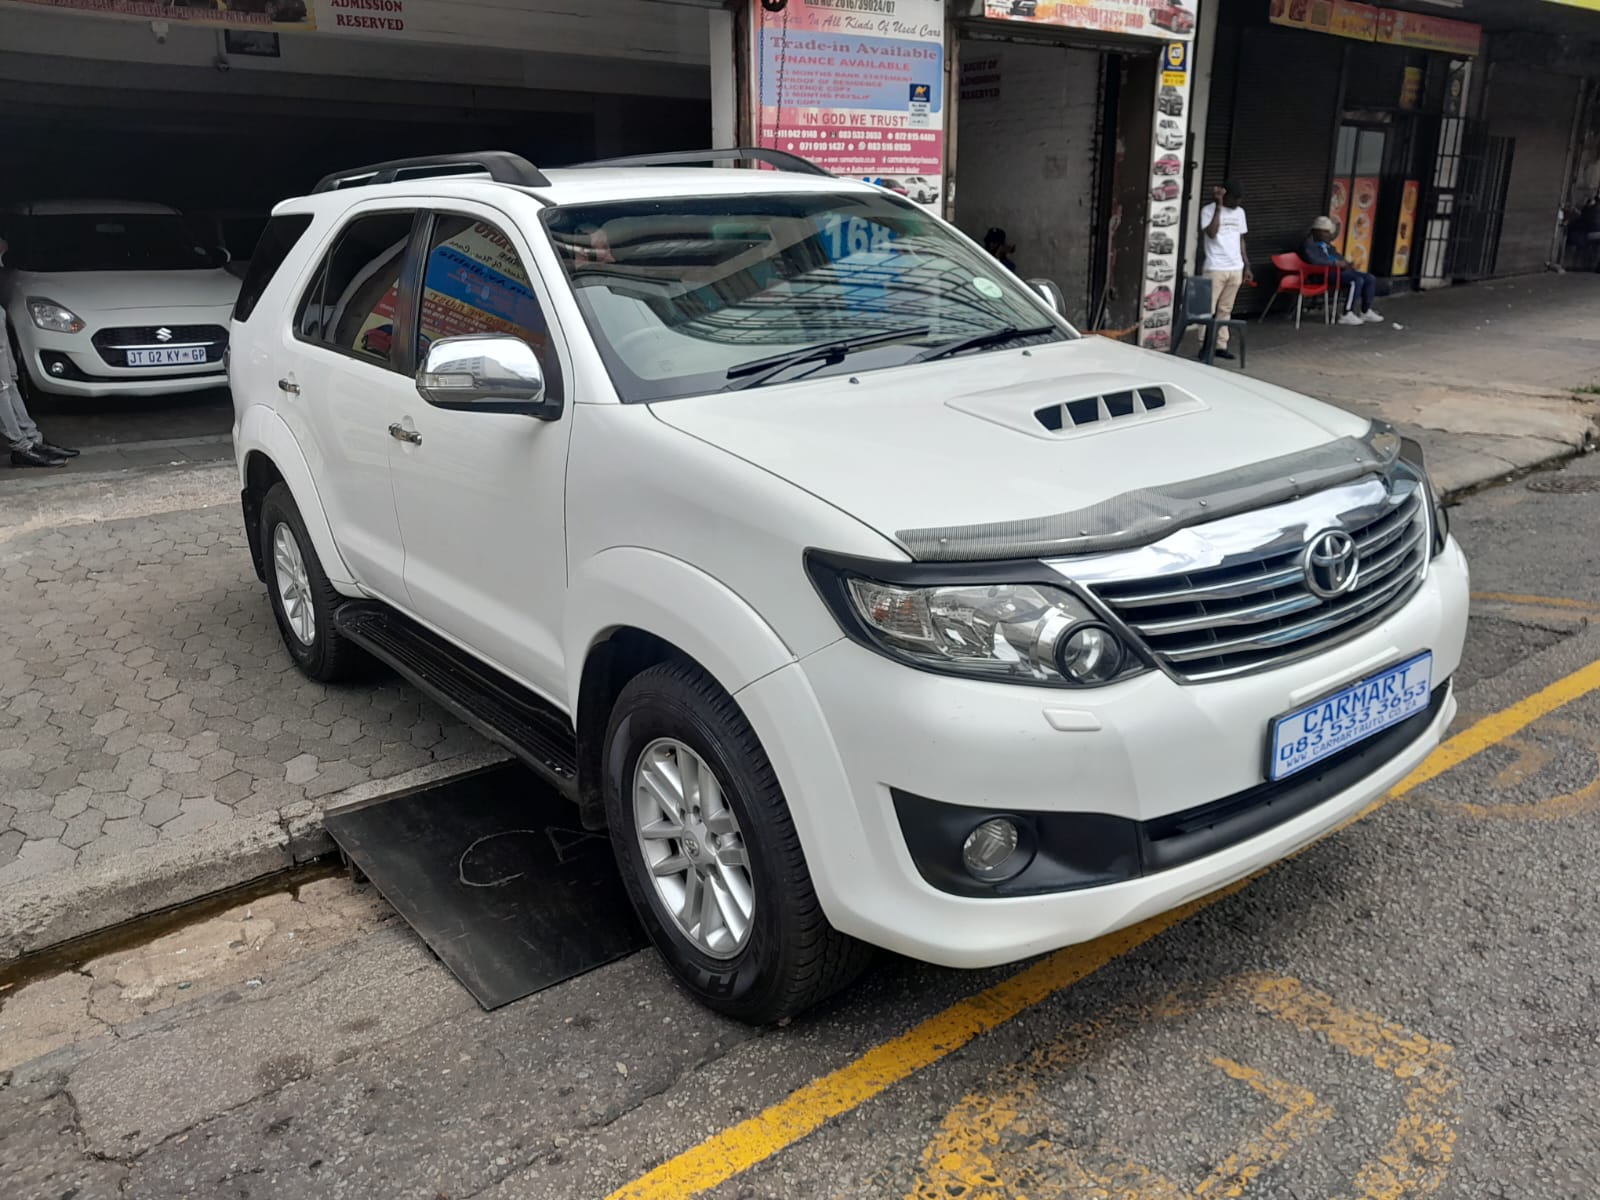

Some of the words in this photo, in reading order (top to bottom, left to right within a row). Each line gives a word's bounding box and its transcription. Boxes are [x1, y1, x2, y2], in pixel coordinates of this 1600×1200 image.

[331, 0, 402, 12] ADMISSION
[336, 14, 404, 31] RESERVED
[808, 12, 819, 26] In
[821, 14, 841, 28] All
[844, 16, 874, 31] Kinds
[877, 19, 889, 34] Of
[892, 20, 917, 35] Used
[919, 24, 942, 38] Cars
[770, 36, 850, 53] Trade-in
[856, 42, 937, 60] Available
[774, 54, 835, 66] FINANCE
[840, 58, 911, 72] AVAILABLE
[823, 114, 845, 125] GOD
[850, 114, 866, 126] WE
[130, 351, 143, 364] JT
[149, 350, 162, 363] 02
[167, 349, 181, 362] KY
[192, 348, 205, 361] GP
[1304, 667, 1412, 733] CARMART
[1281, 728, 1324, 761] 083
[1330, 706, 1370, 737] 533
[1377, 680, 1427, 714] 3653
